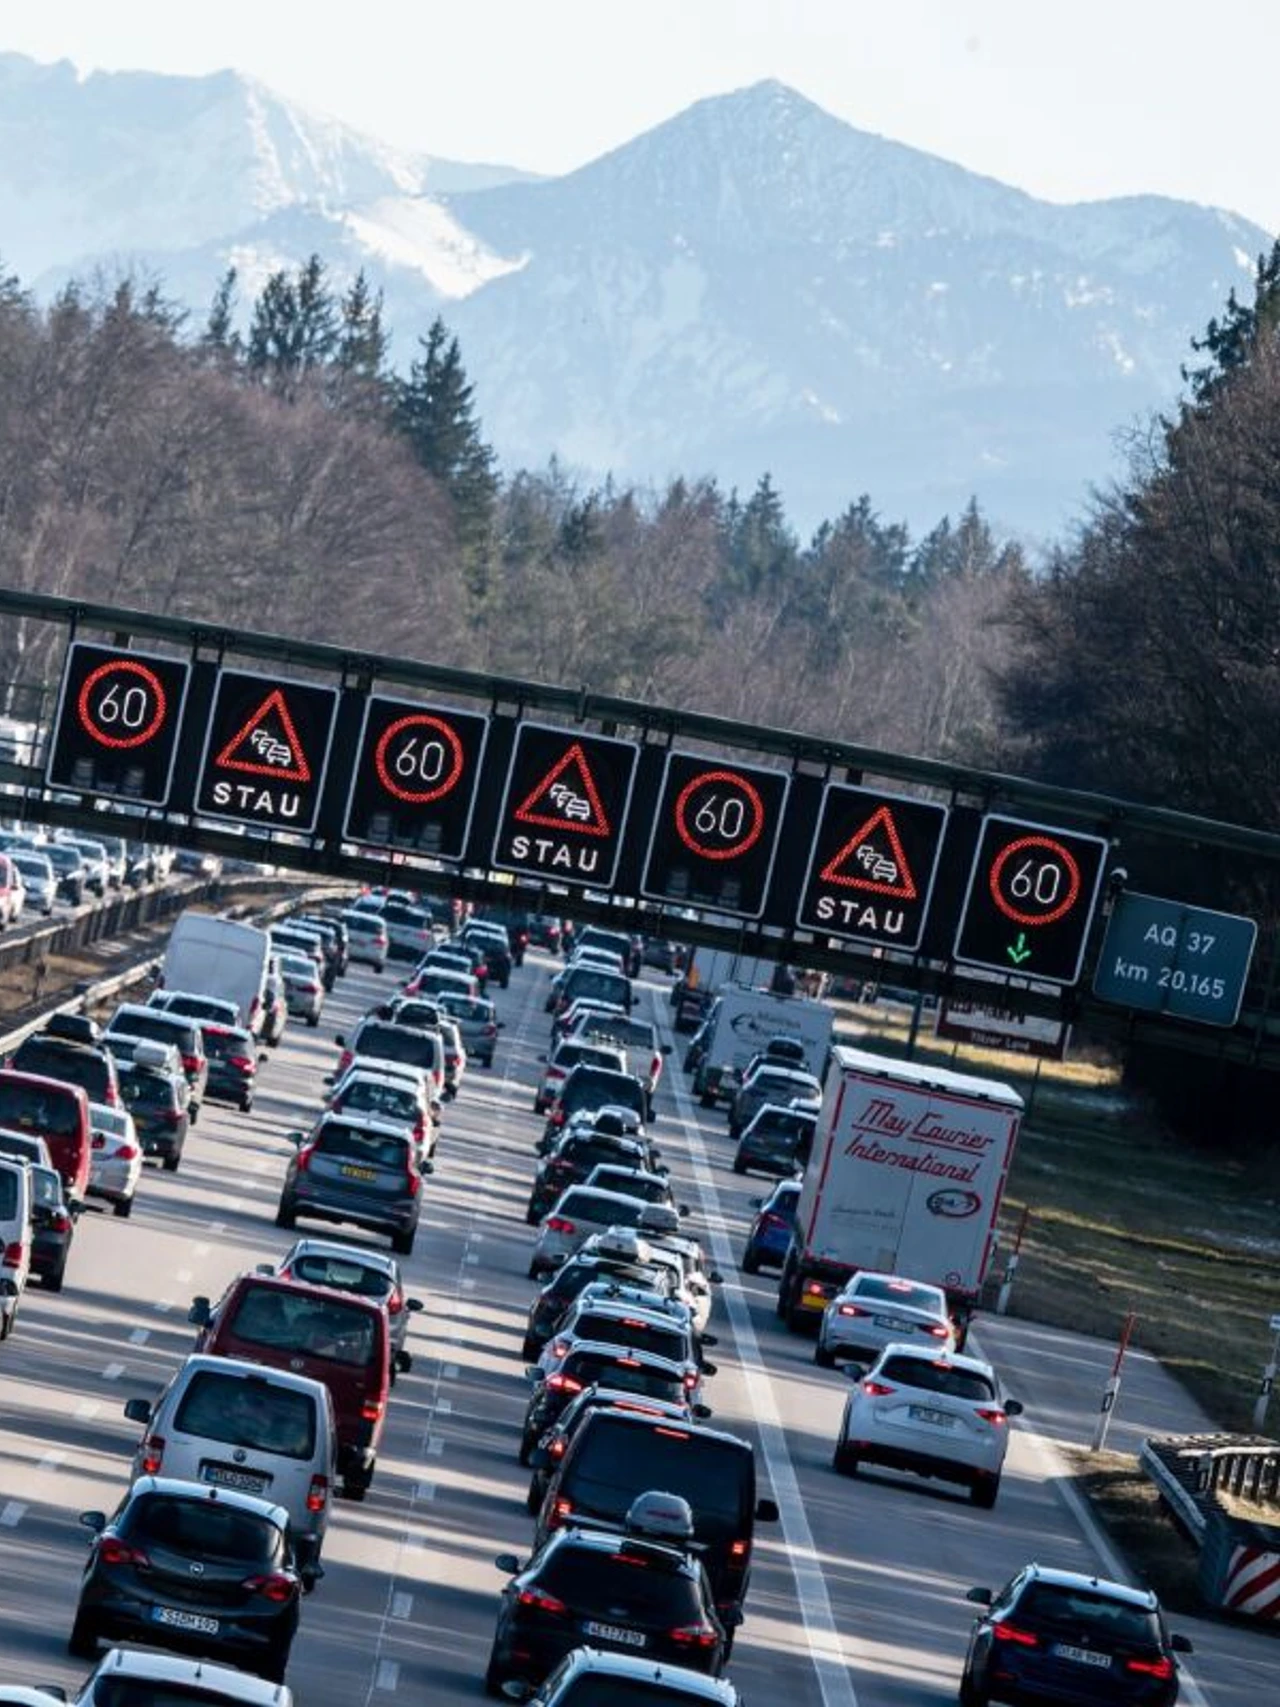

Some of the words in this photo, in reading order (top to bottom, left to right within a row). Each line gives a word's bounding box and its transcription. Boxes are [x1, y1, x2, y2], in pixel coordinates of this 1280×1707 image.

[97, 684, 147, 727] 60
[395, 738, 445, 781] 60
[213, 782, 300, 817] STAU
[695, 795, 745, 838] 60
[511, 836, 599, 872] STAU
[1010, 859, 1060, 903] 60
[817, 896, 904, 934] STAU
[1143, 923, 1177, 948] AQ
[1187, 932, 1216, 956] 37
[1114, 957, 1148, 983] km
[1157, 967, 1225, 1000] 20.165
[853, 1099, 912, 1137] May
[912, 1112, 996, 1150] Courier
[845, 1134, 980, 1183] International
